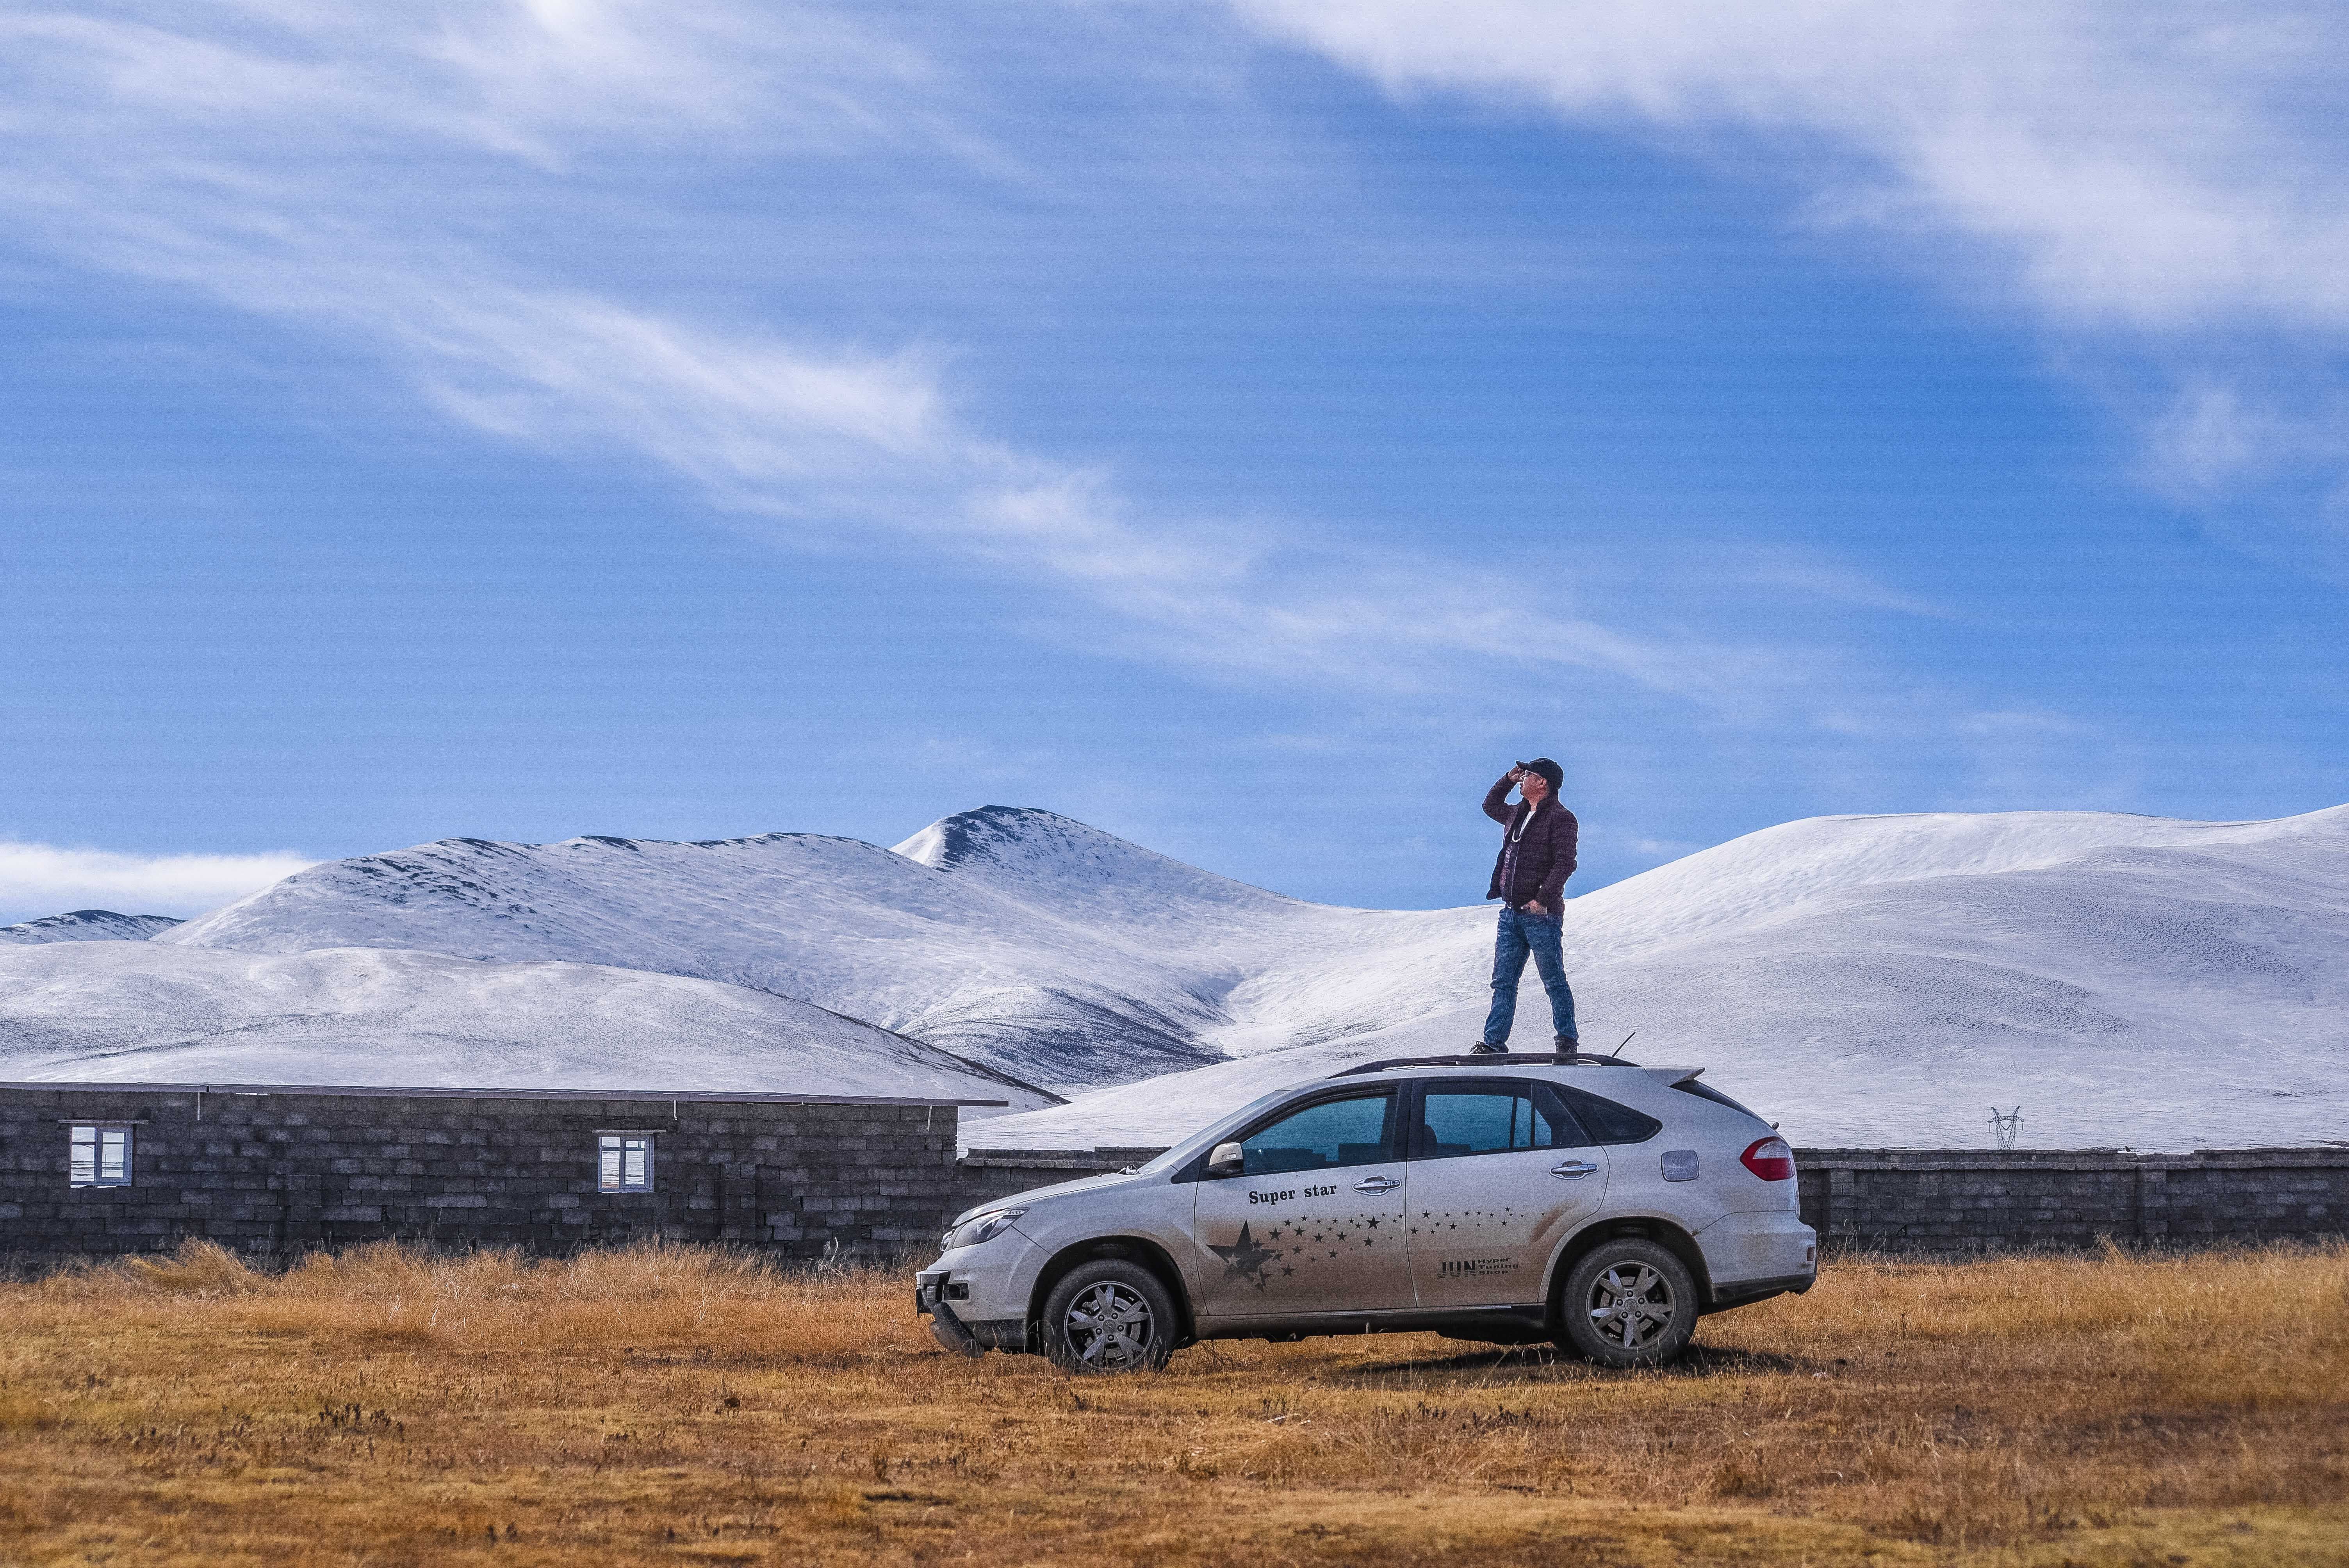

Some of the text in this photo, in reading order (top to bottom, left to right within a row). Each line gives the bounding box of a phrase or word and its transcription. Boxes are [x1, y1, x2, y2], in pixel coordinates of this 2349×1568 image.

[1249, 1185, 1337, 1205] Super star
[1437, 1260, 1476, 1278] JUN
